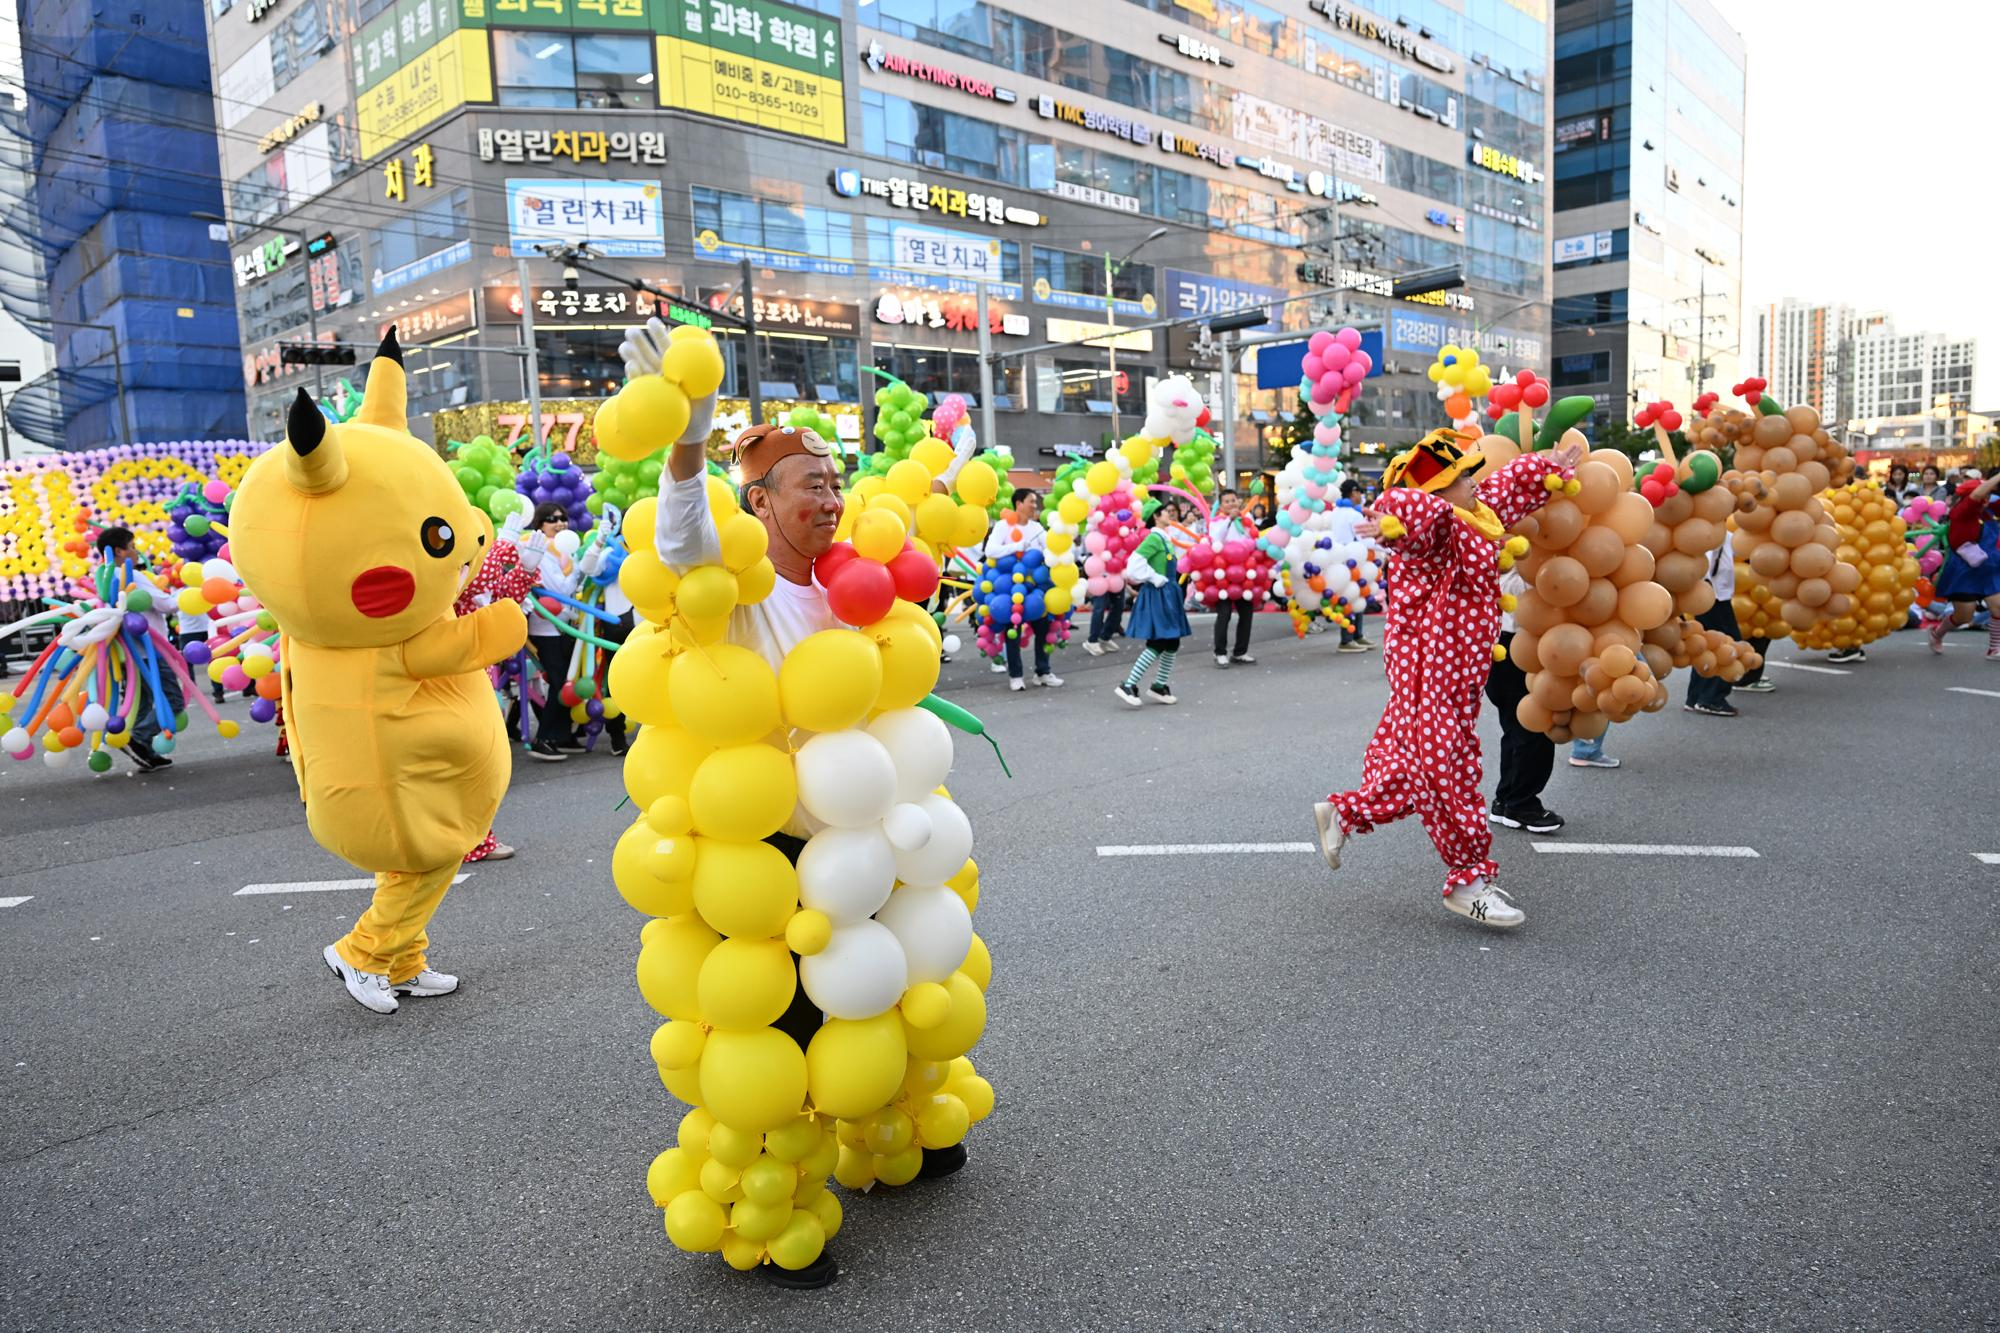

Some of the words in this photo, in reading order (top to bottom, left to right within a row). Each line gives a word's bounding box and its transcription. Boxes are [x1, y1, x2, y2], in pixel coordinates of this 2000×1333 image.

[710, 1, 763, 44] 과학
[768, 17, 818, 59] 학원
[909, 60, 958, 89] FLYING
[959, 74, 994, 98] YOGA
[715, 83, 819, 118] 010-8365-1029
[493, 128, 668, 164] 열린치과의원
[385, 143, 435, 202] 치과
[534, 199, 647, 226] 열린치과
[909, 239, 989, 273] 열린치과
[536, 289, 630, 317] 육공포차
[1470, 900, 1489, 920] NY
